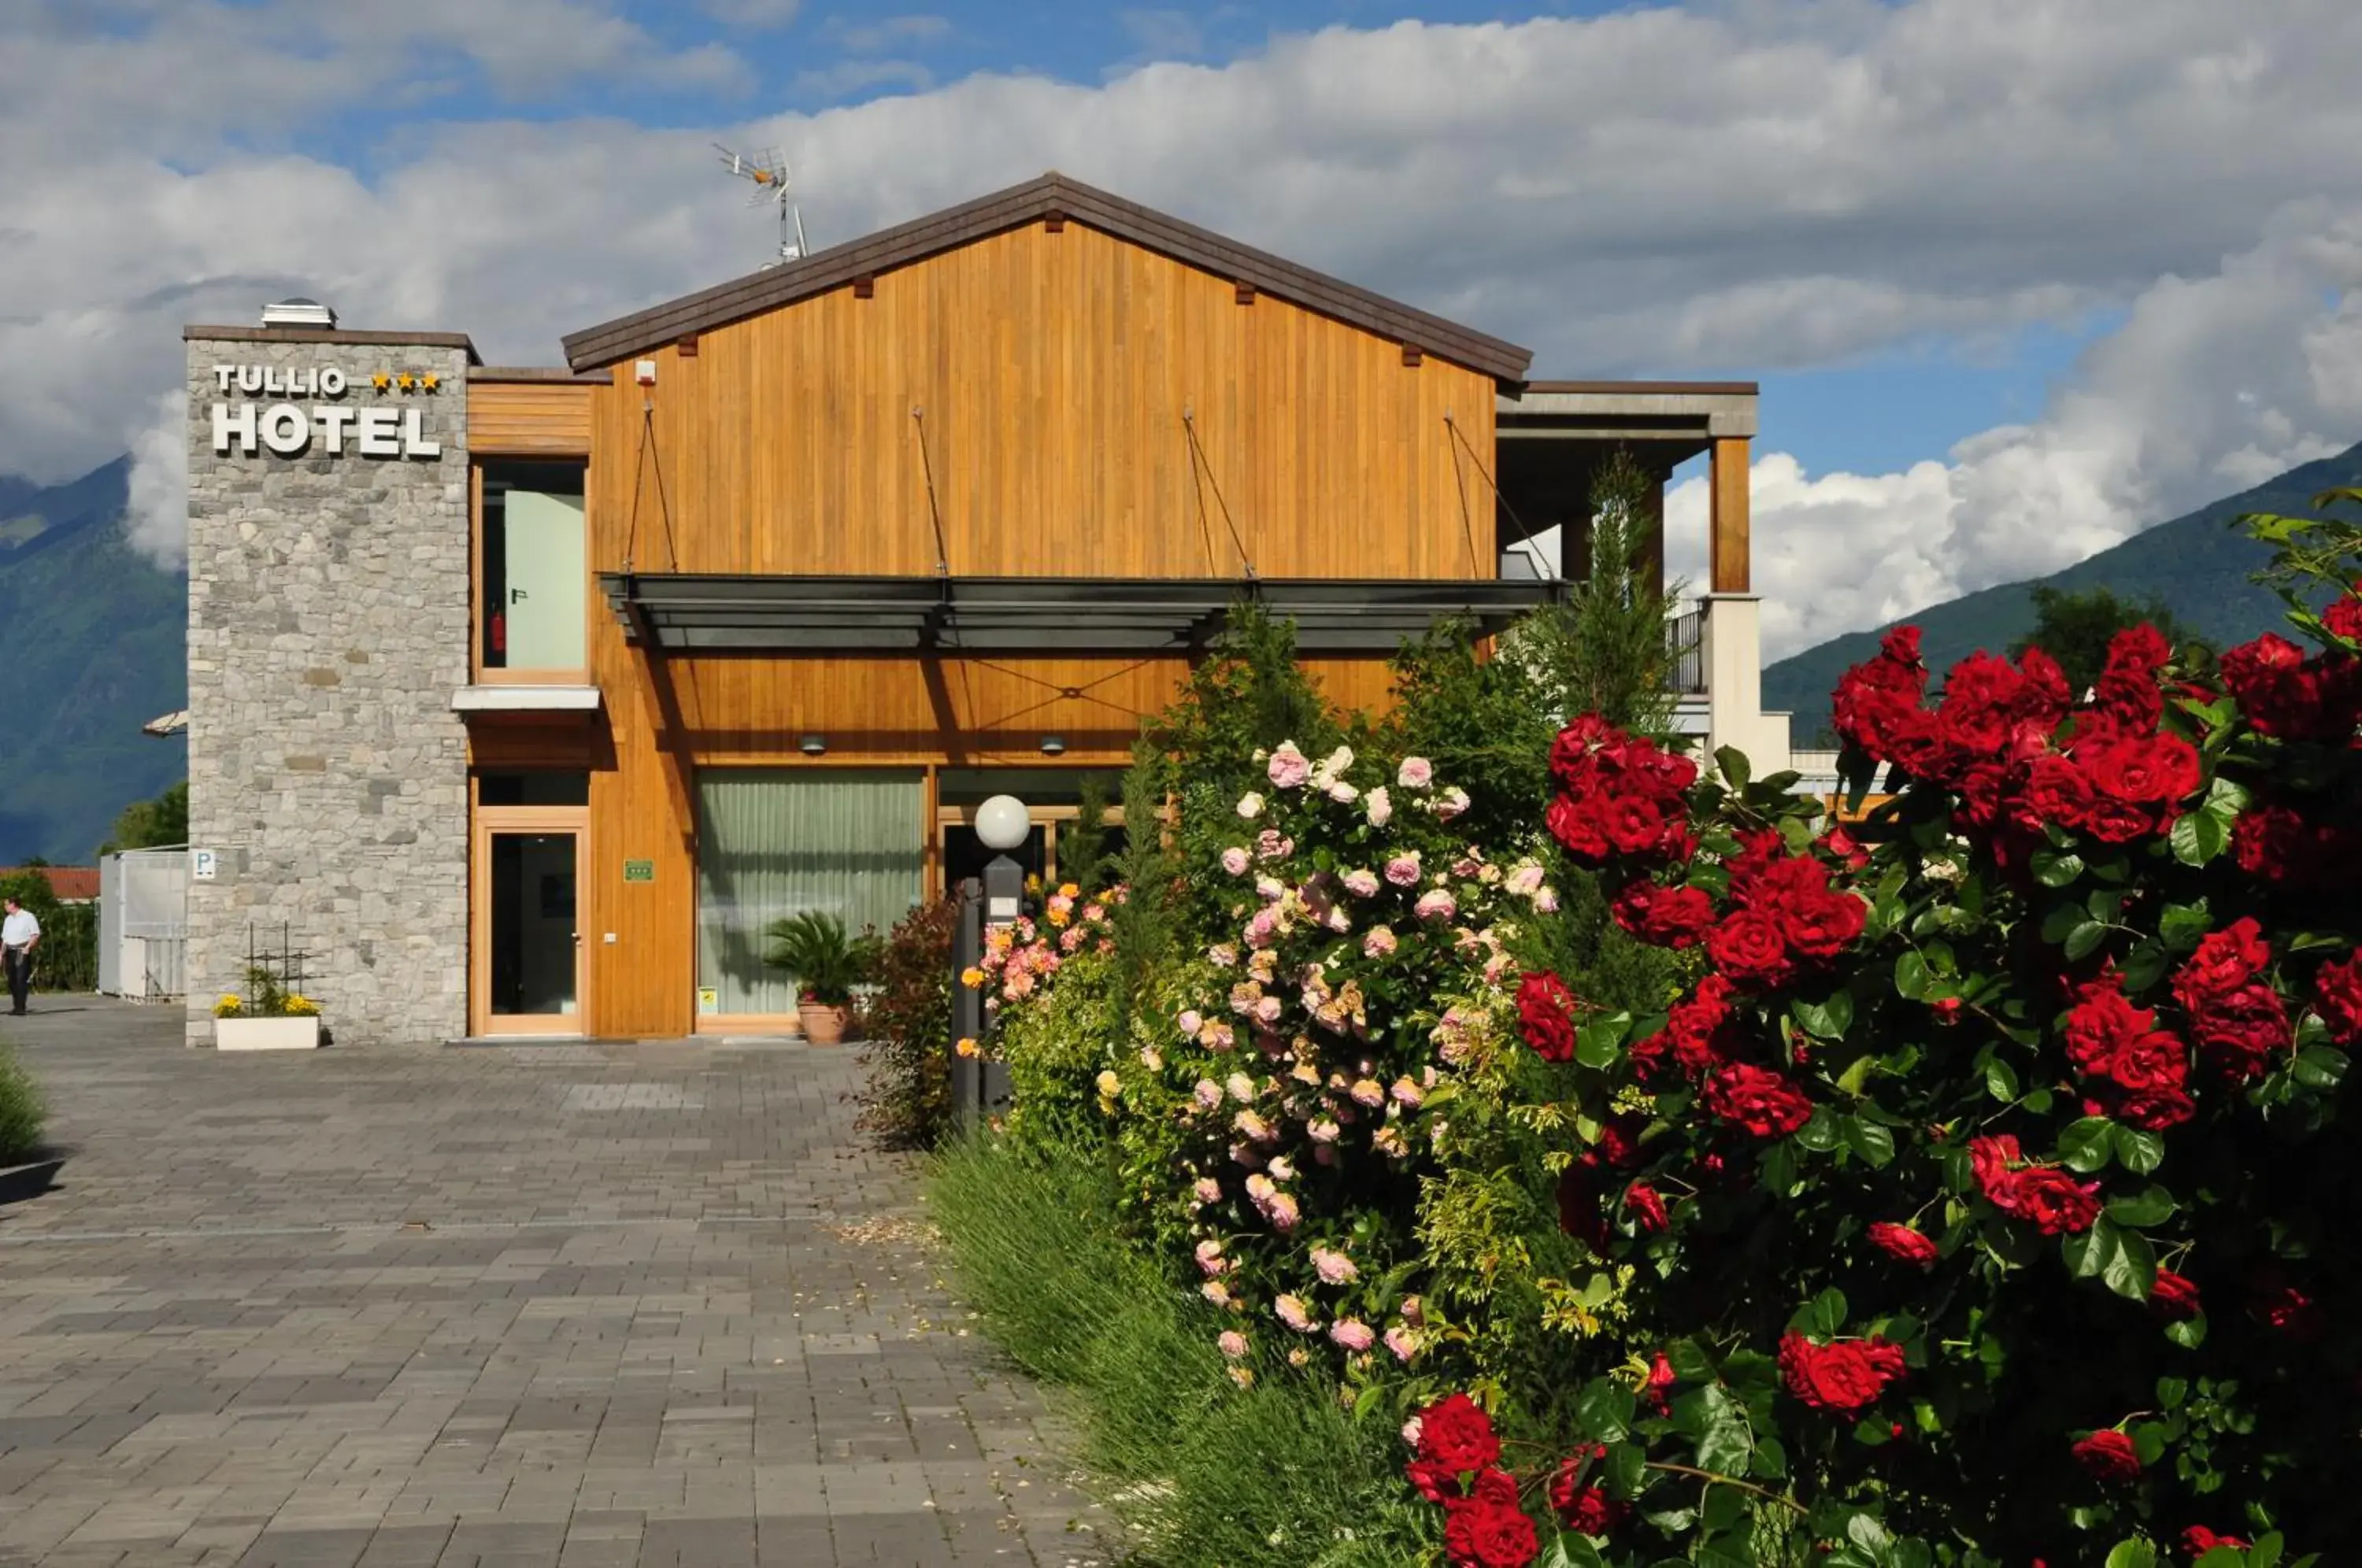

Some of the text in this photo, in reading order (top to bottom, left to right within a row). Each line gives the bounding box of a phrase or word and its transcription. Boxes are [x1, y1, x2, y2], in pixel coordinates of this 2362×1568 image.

[213, 364, 346, 394] TULLIO
[213, 403, 441, 456] HOTEL
[198, 852, 211, 870] P
